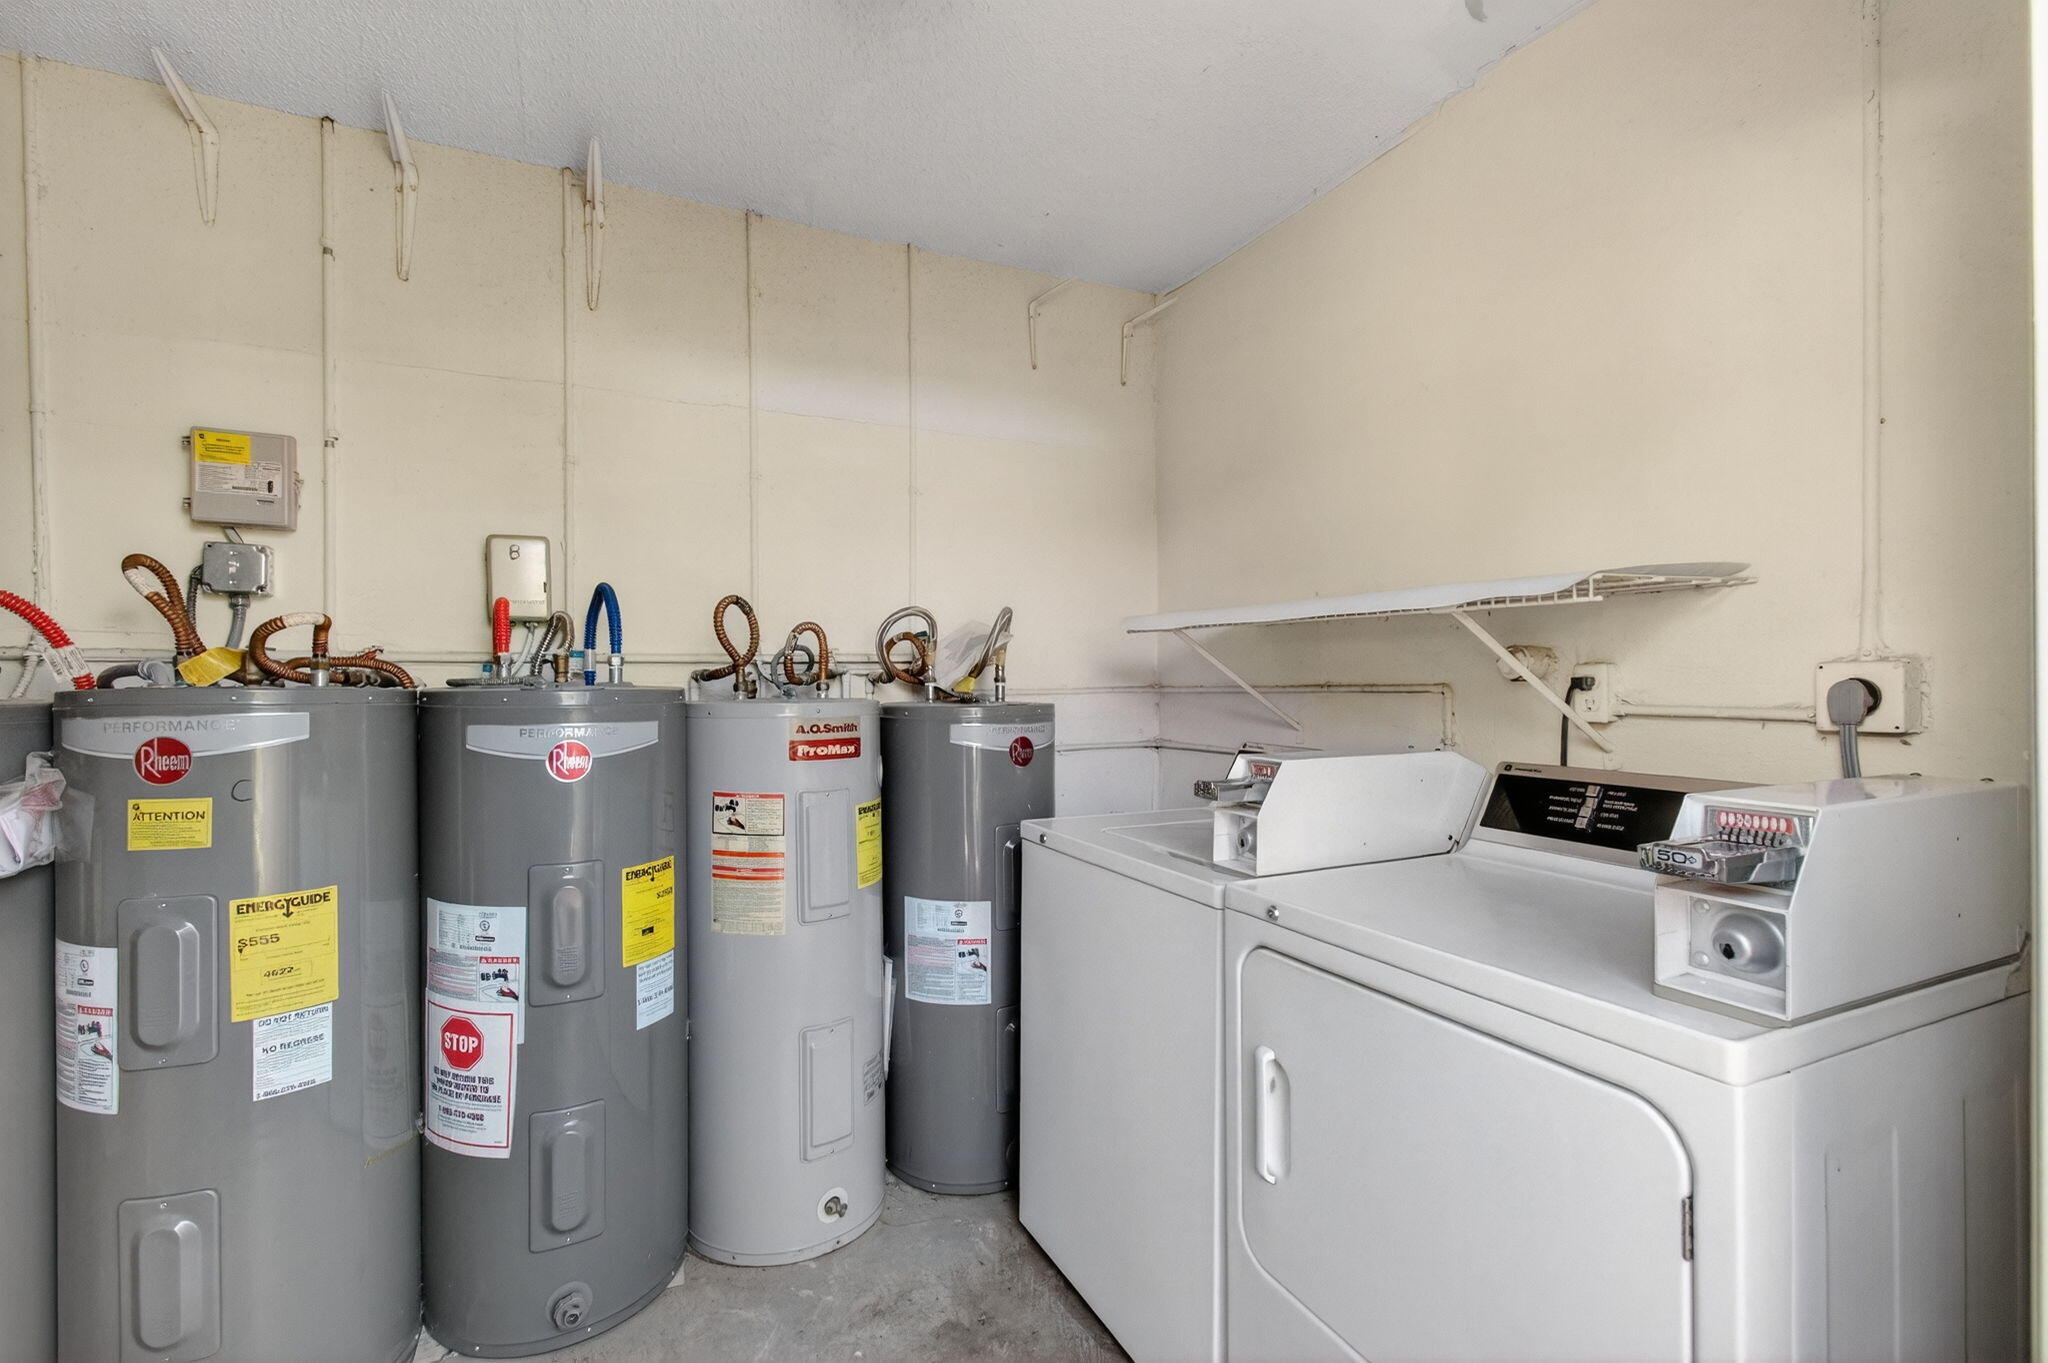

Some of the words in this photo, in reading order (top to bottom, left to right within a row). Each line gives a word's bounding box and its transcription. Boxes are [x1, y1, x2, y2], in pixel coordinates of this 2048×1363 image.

[103, 719, 240, 734] PERFORMANCE
[141, 737, 190, 778] Rheem
[797, 744, 856, 757] ProMax
[132, 810, 206, 823] ATTENTION
[238, 933, 280, 949] $555
[444, 1032, 479, 1054] STOP
